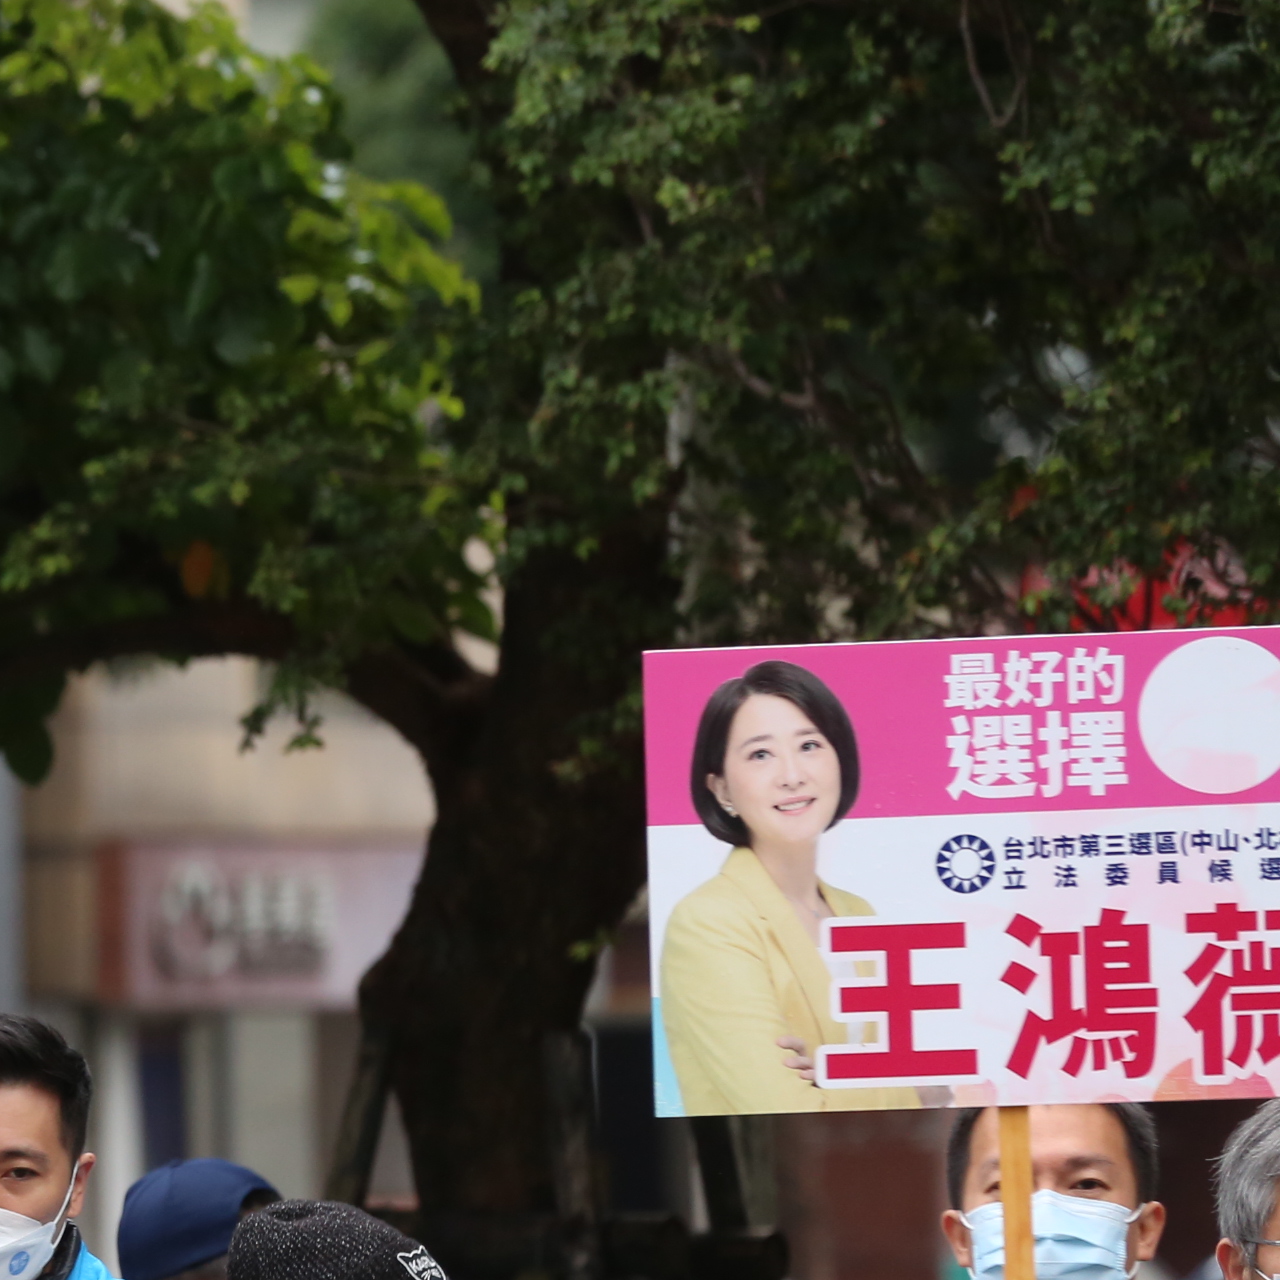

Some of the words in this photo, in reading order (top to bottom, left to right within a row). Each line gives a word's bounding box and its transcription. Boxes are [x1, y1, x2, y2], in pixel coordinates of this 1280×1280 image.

[943, 647, 1125, 709] 最好的
[945, 710, 1129, 801] 選擇
[1003, 827, 1280, 861] 台北市第三選區(中山、北
[1003, 857, 1280, 890] 立法委員候選
[825, 902, 1280, 1081] 王鴻薇
